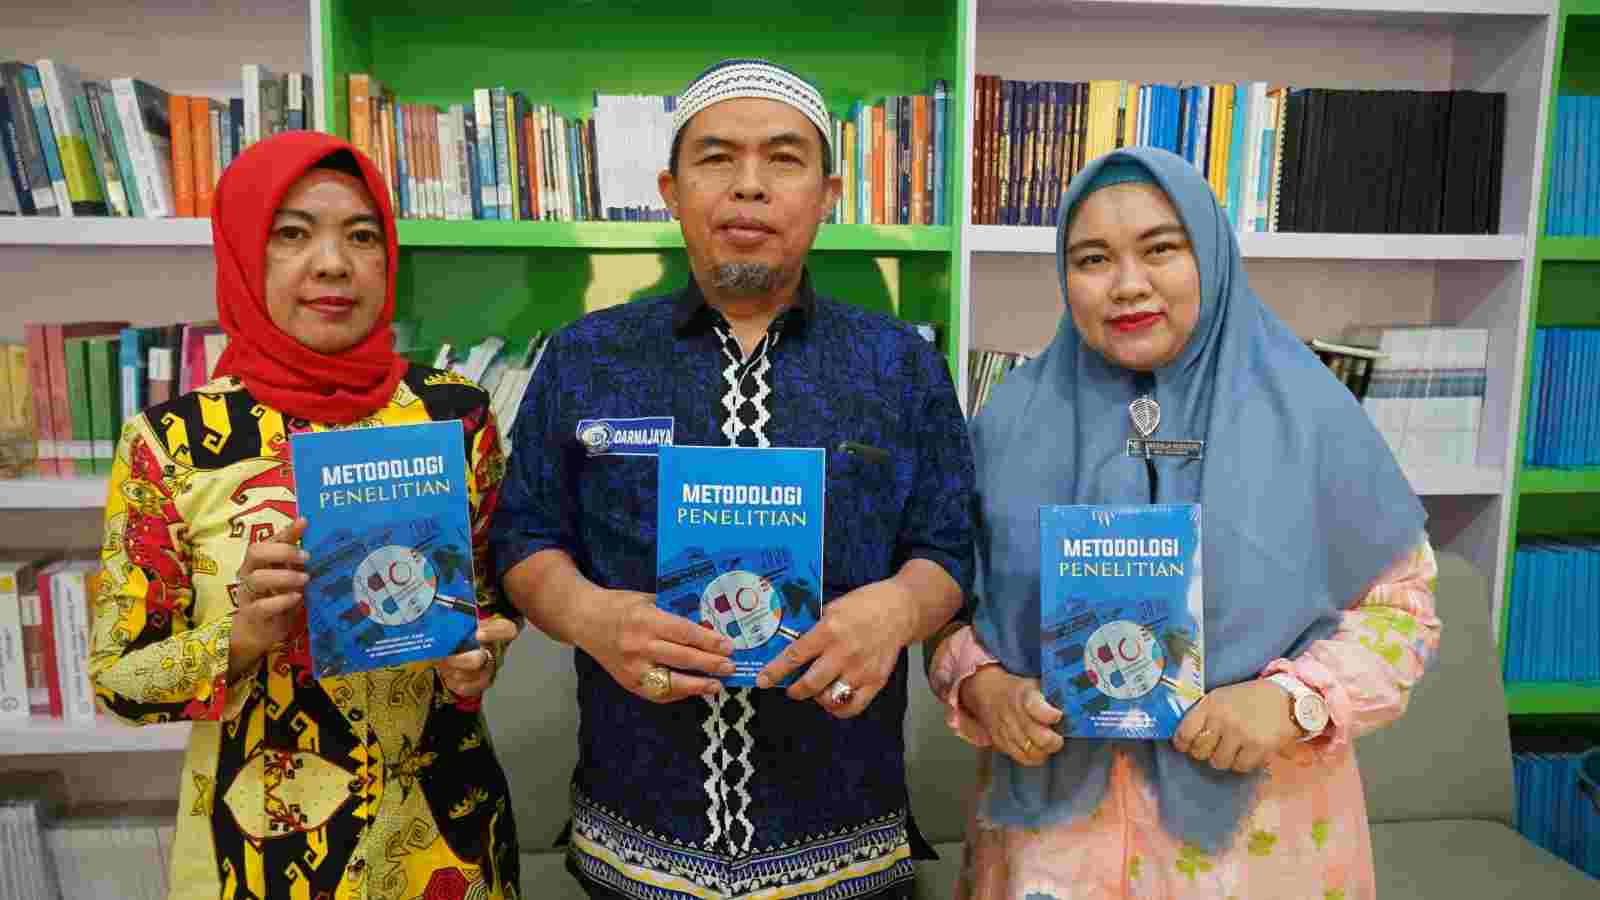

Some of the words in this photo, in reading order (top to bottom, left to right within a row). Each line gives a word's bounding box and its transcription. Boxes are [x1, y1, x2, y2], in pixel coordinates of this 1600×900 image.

[321, 455, 444, 485] METODOLOGI
[319, 479, 450, 508] PENELITIAN
[682, 483, 802, 506] METODOLOGI
[677, 507, 807, 527] PENELITIAN
[1063, 538, 1178, 558] METODOLOGI
[1059, 561, 1185, 577] PENELITIAN
